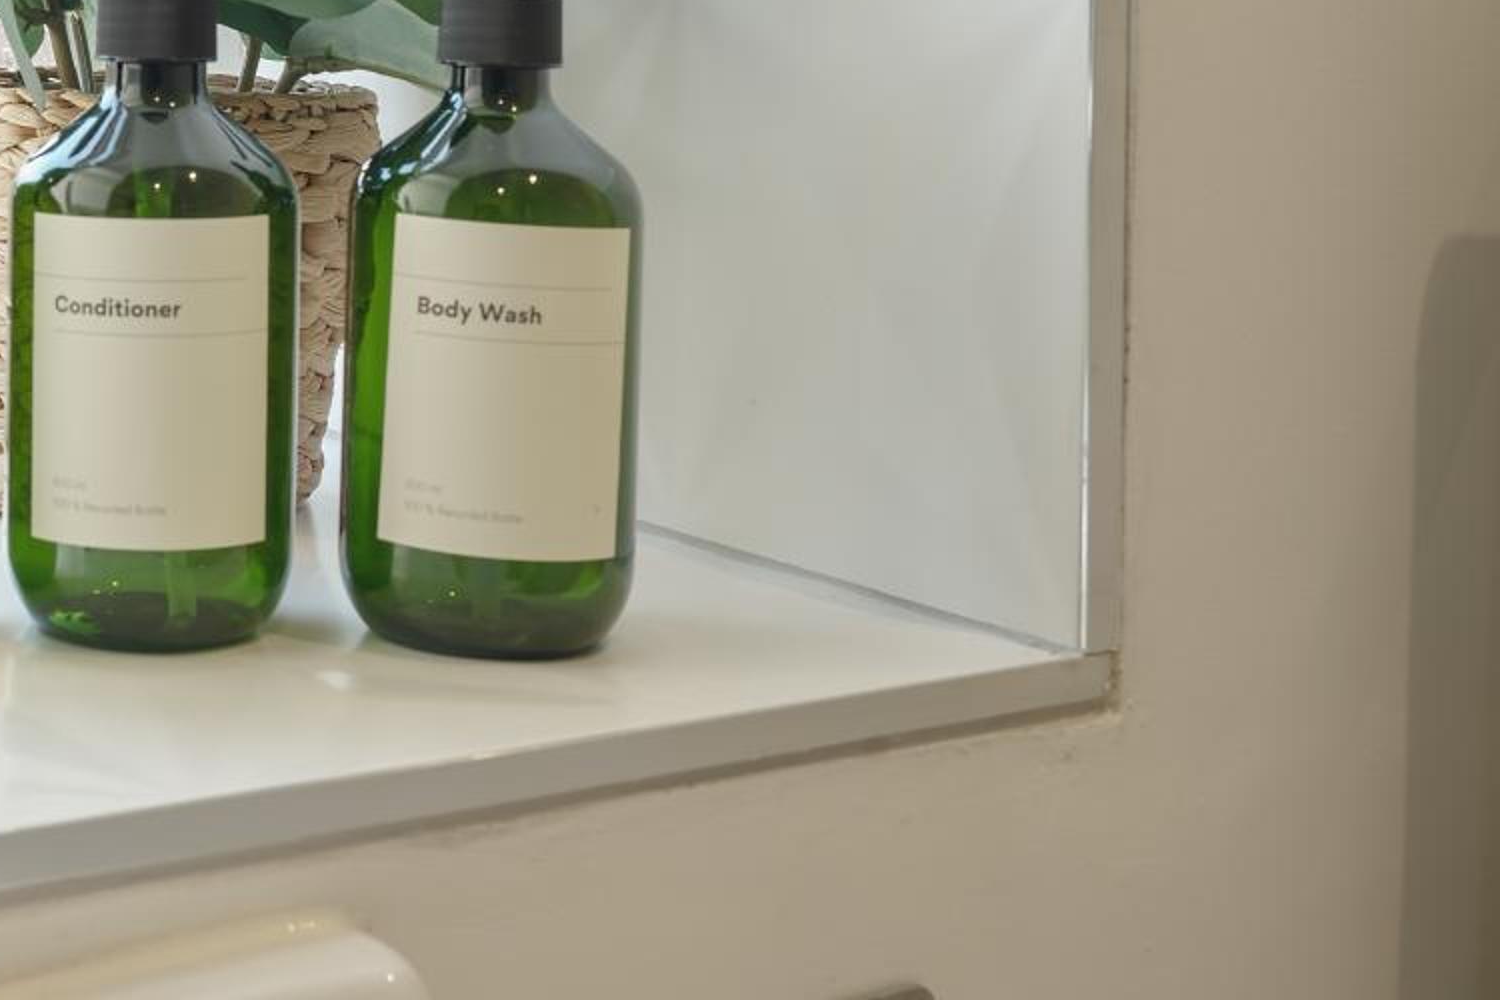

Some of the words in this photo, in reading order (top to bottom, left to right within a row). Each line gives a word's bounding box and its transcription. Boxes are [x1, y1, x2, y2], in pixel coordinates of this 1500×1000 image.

[54, 295, 181, 320] Conditioner
[417, 296, 473, 325] Body
[479, 302, 543, 325] Wash
